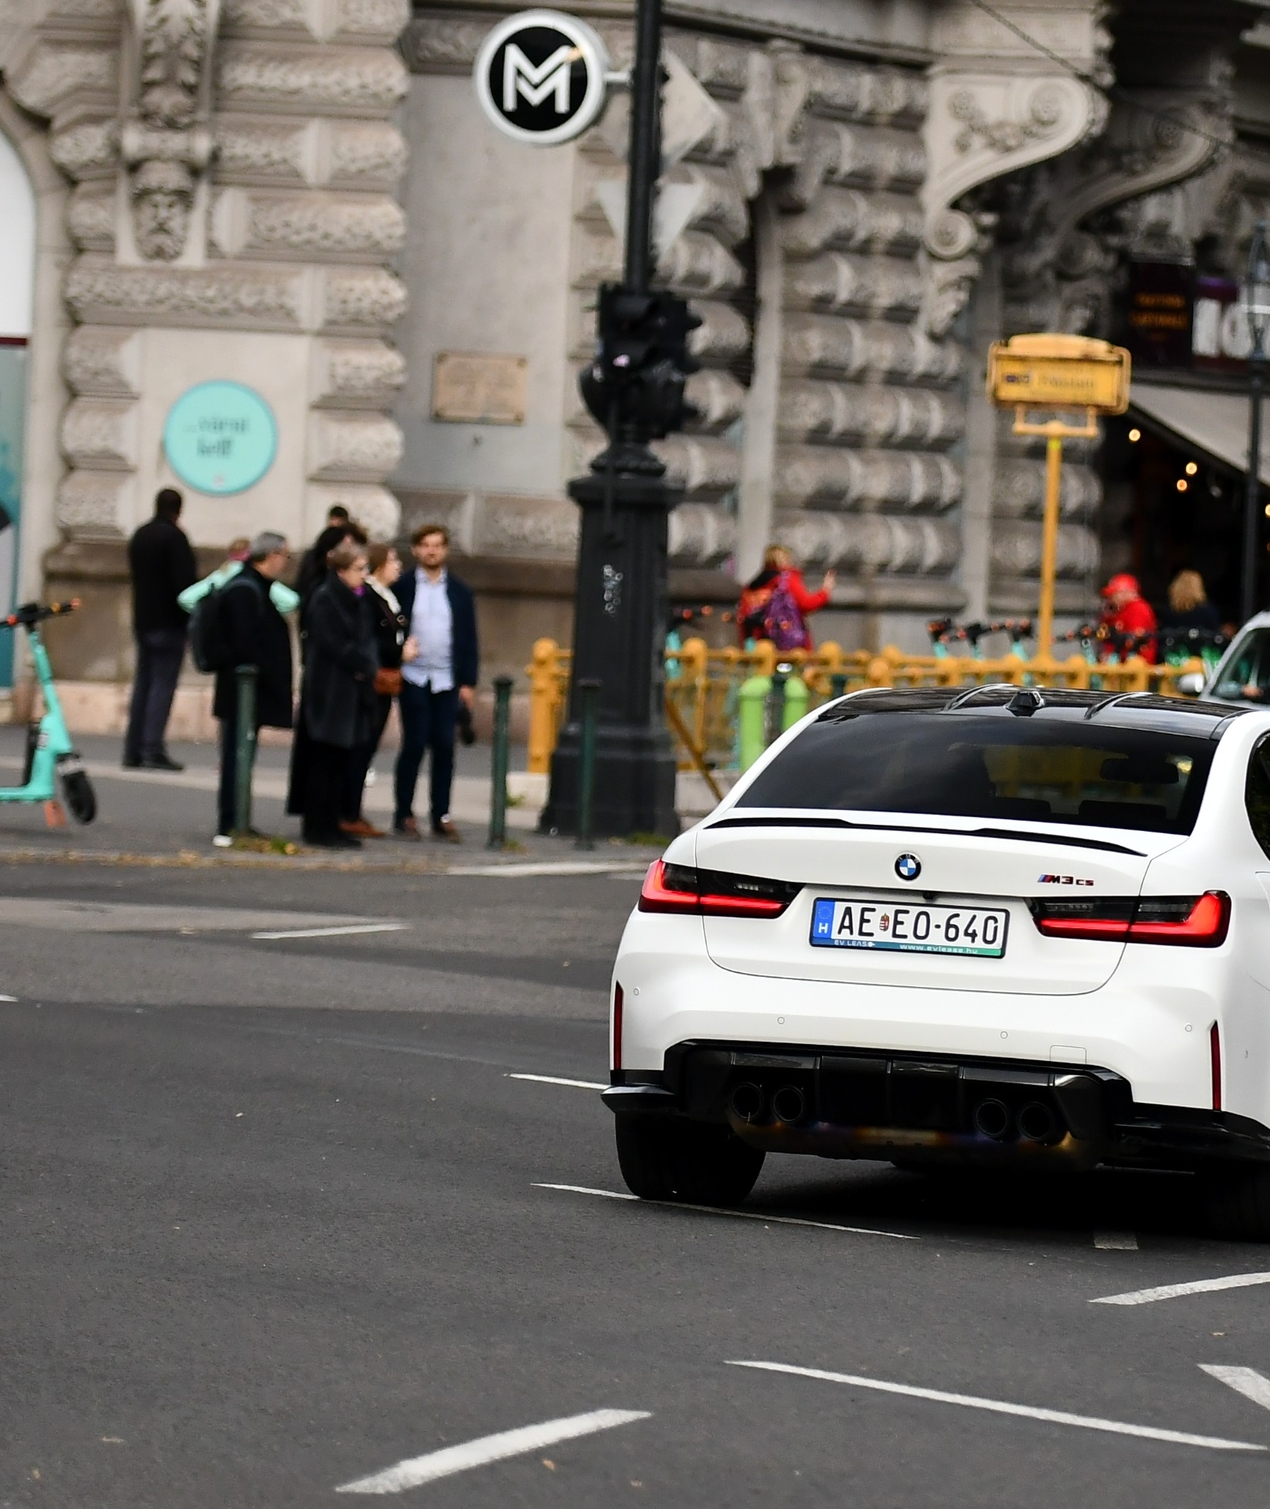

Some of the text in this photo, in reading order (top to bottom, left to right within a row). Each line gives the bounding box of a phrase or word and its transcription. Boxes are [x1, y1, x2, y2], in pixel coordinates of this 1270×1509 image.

[503, 43, 581, 114] M
[1046, 874, 1074, 885] M3
[818, 922, 828, 934] H
[837, 906, 999, 945] AE EO-640
